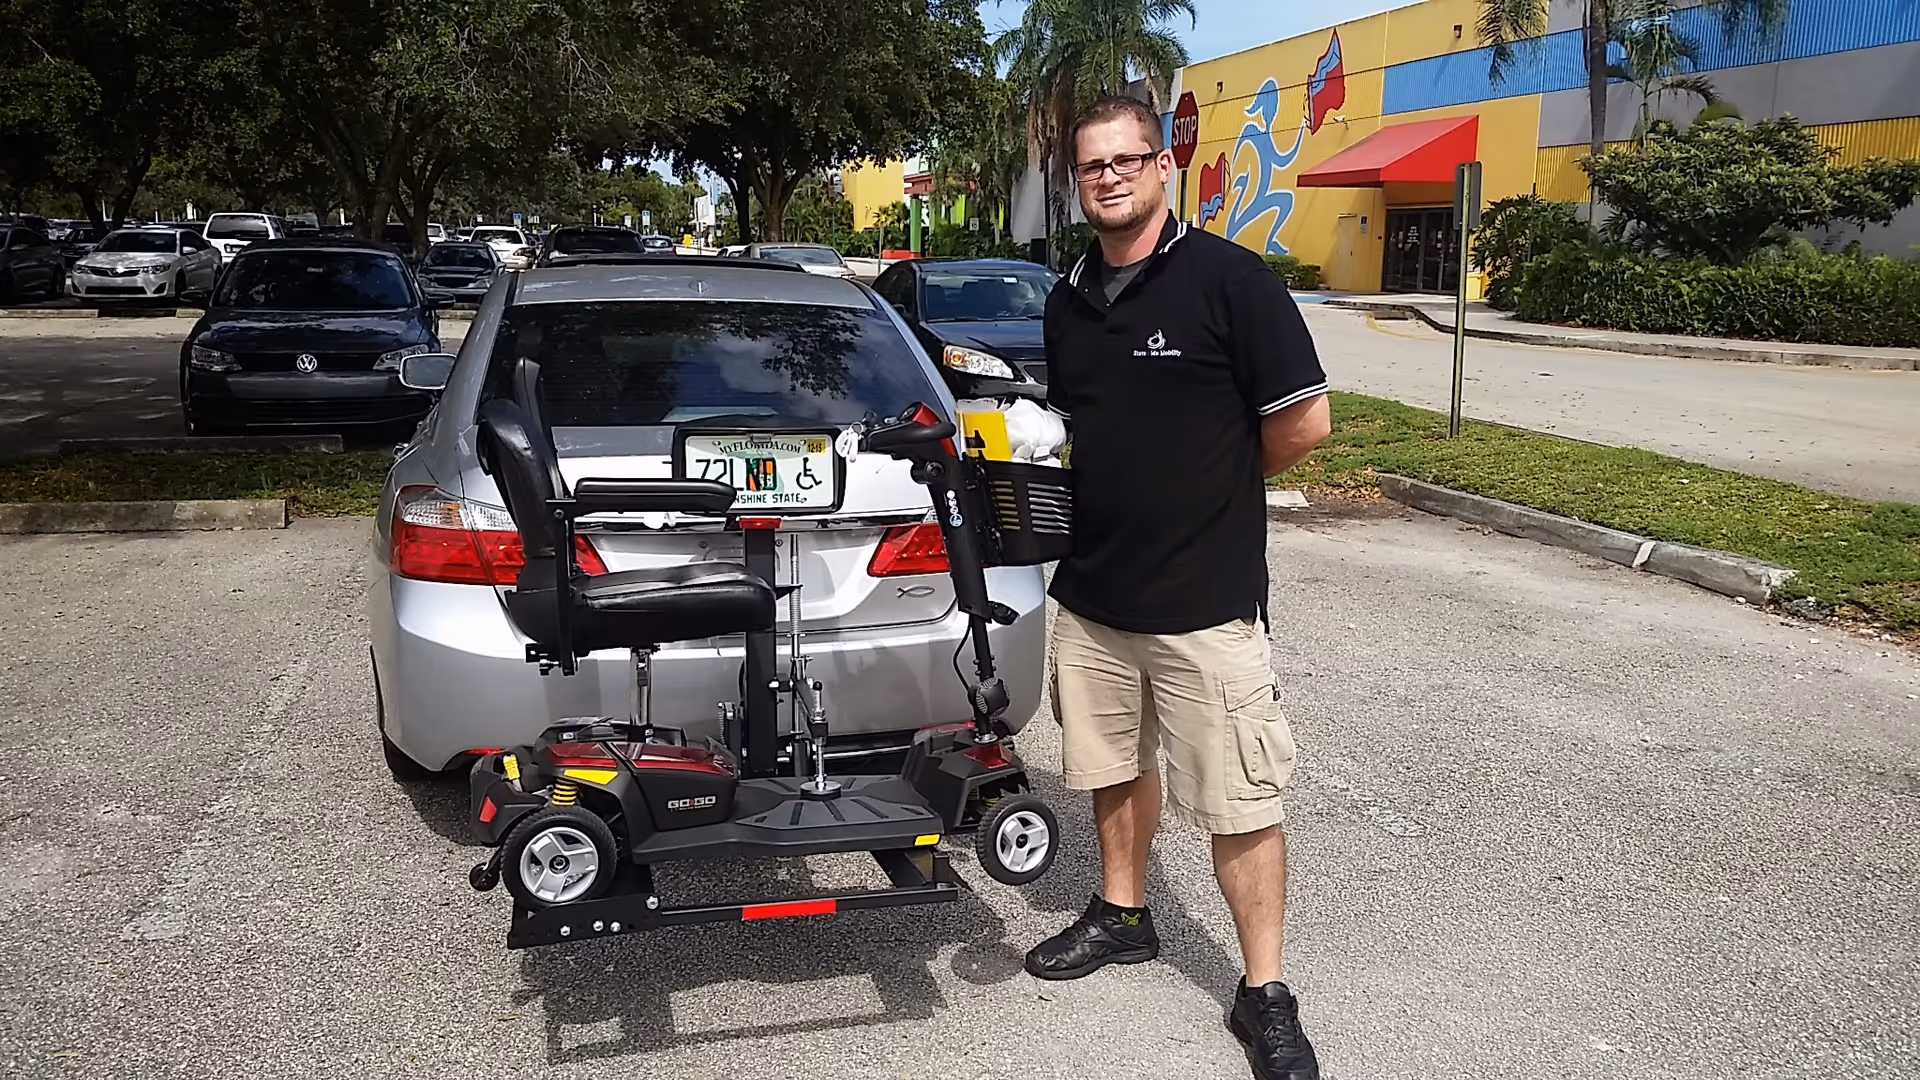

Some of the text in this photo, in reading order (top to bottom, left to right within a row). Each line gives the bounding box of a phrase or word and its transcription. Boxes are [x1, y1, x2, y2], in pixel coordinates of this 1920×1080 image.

[1173, 116, 1197, 146] STOP
[735, 493, 800, 504] NSHINE STATE
